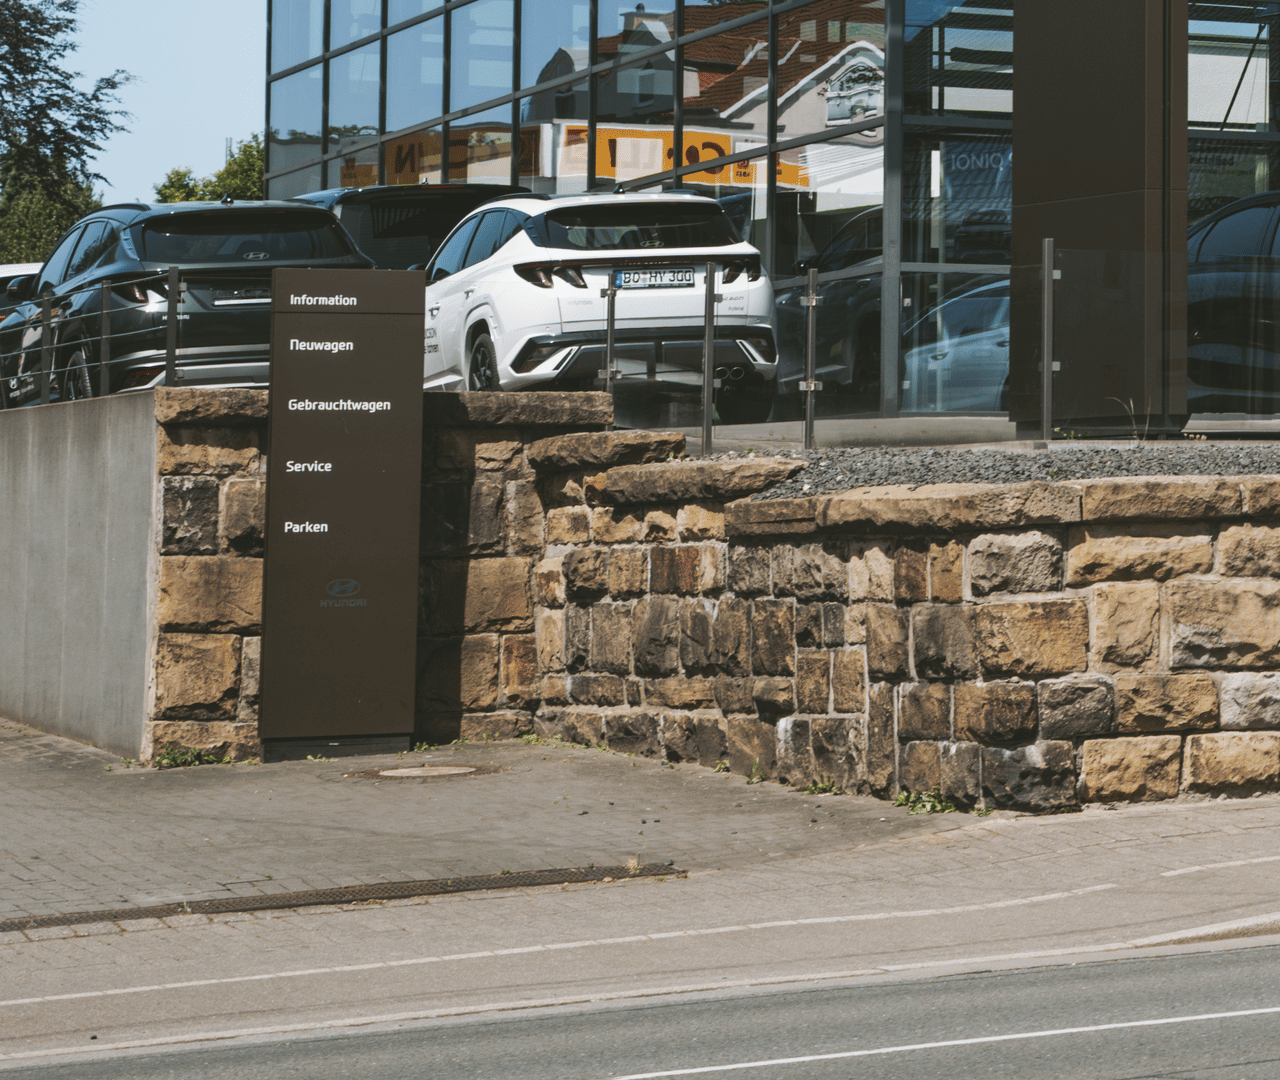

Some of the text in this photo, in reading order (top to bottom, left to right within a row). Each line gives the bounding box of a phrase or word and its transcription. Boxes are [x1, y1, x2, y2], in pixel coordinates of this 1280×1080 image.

[623, 269, 692, 284] BO HY 300
[289, 293, 358, 306] Information
[289, 338, 354, 354] Neuwagen
[287, 398, 392, 414] Gebrauchtwagen
[286, 460, 333, 473] Service
[284, 520, 329, 533] Parken
[319, 599, 367, 608] HYUNDAI
